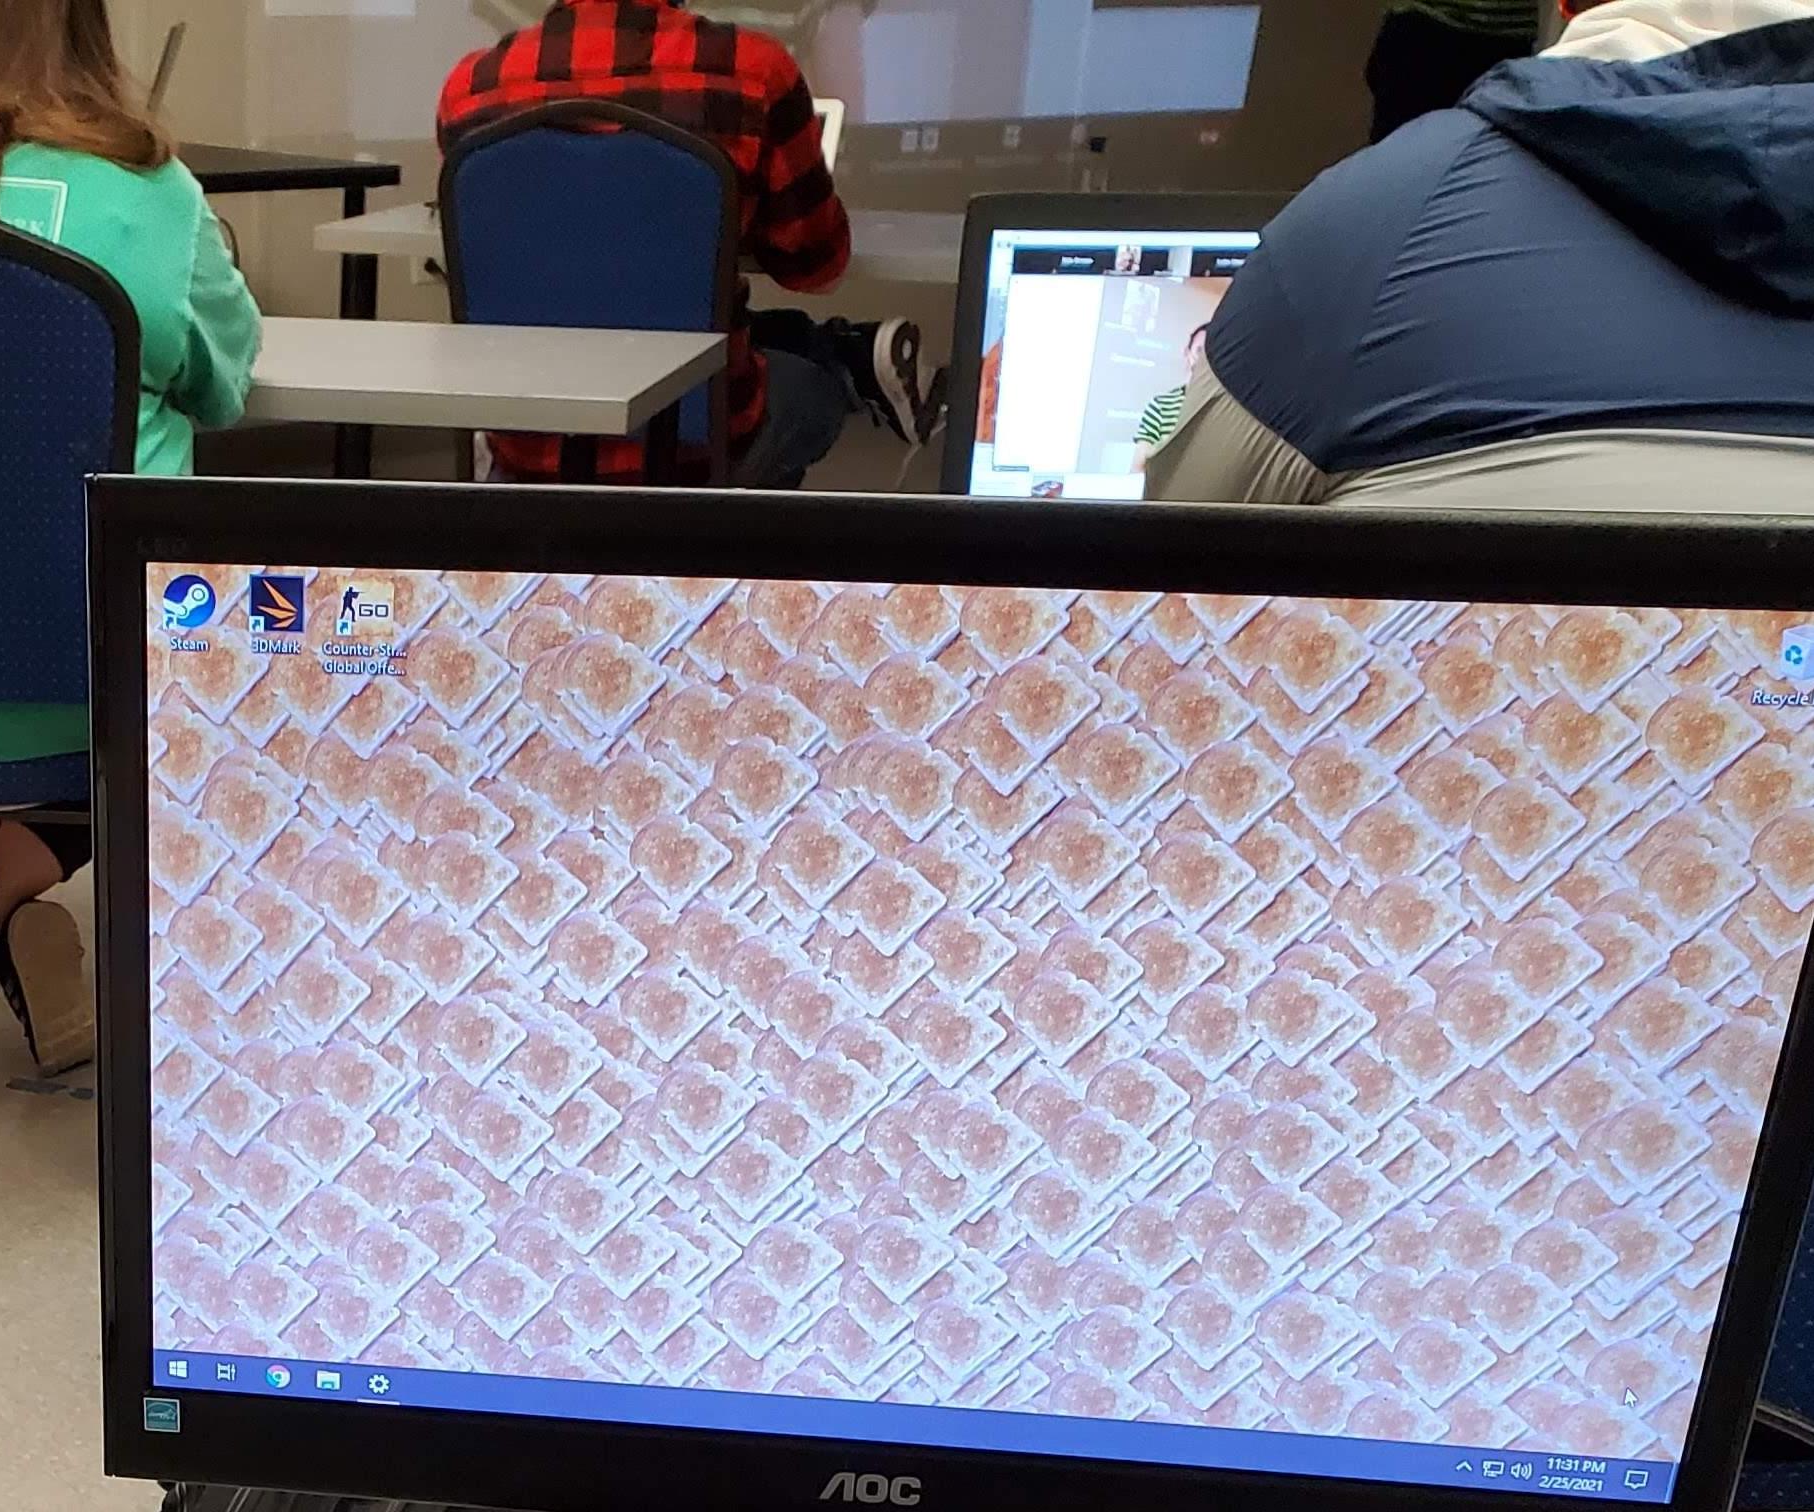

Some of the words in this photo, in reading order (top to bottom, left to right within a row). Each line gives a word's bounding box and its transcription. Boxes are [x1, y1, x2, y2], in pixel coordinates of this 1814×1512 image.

[359, 604, 388, 618] GO
[170, 637, 209, 650] Steam
[251, 639, 300, 653] 3DMark
[324, 661, 365, 674] Global
[1752, 690, 1808, 709] Recycle
[1547, 1457, 1579, 1471] 11:31
[1582, 1461, 1606, 1473] PM
[819, 1472, 921, 1505] AOC
[1539, 1476, 1602, 1491] 2/25/2021
